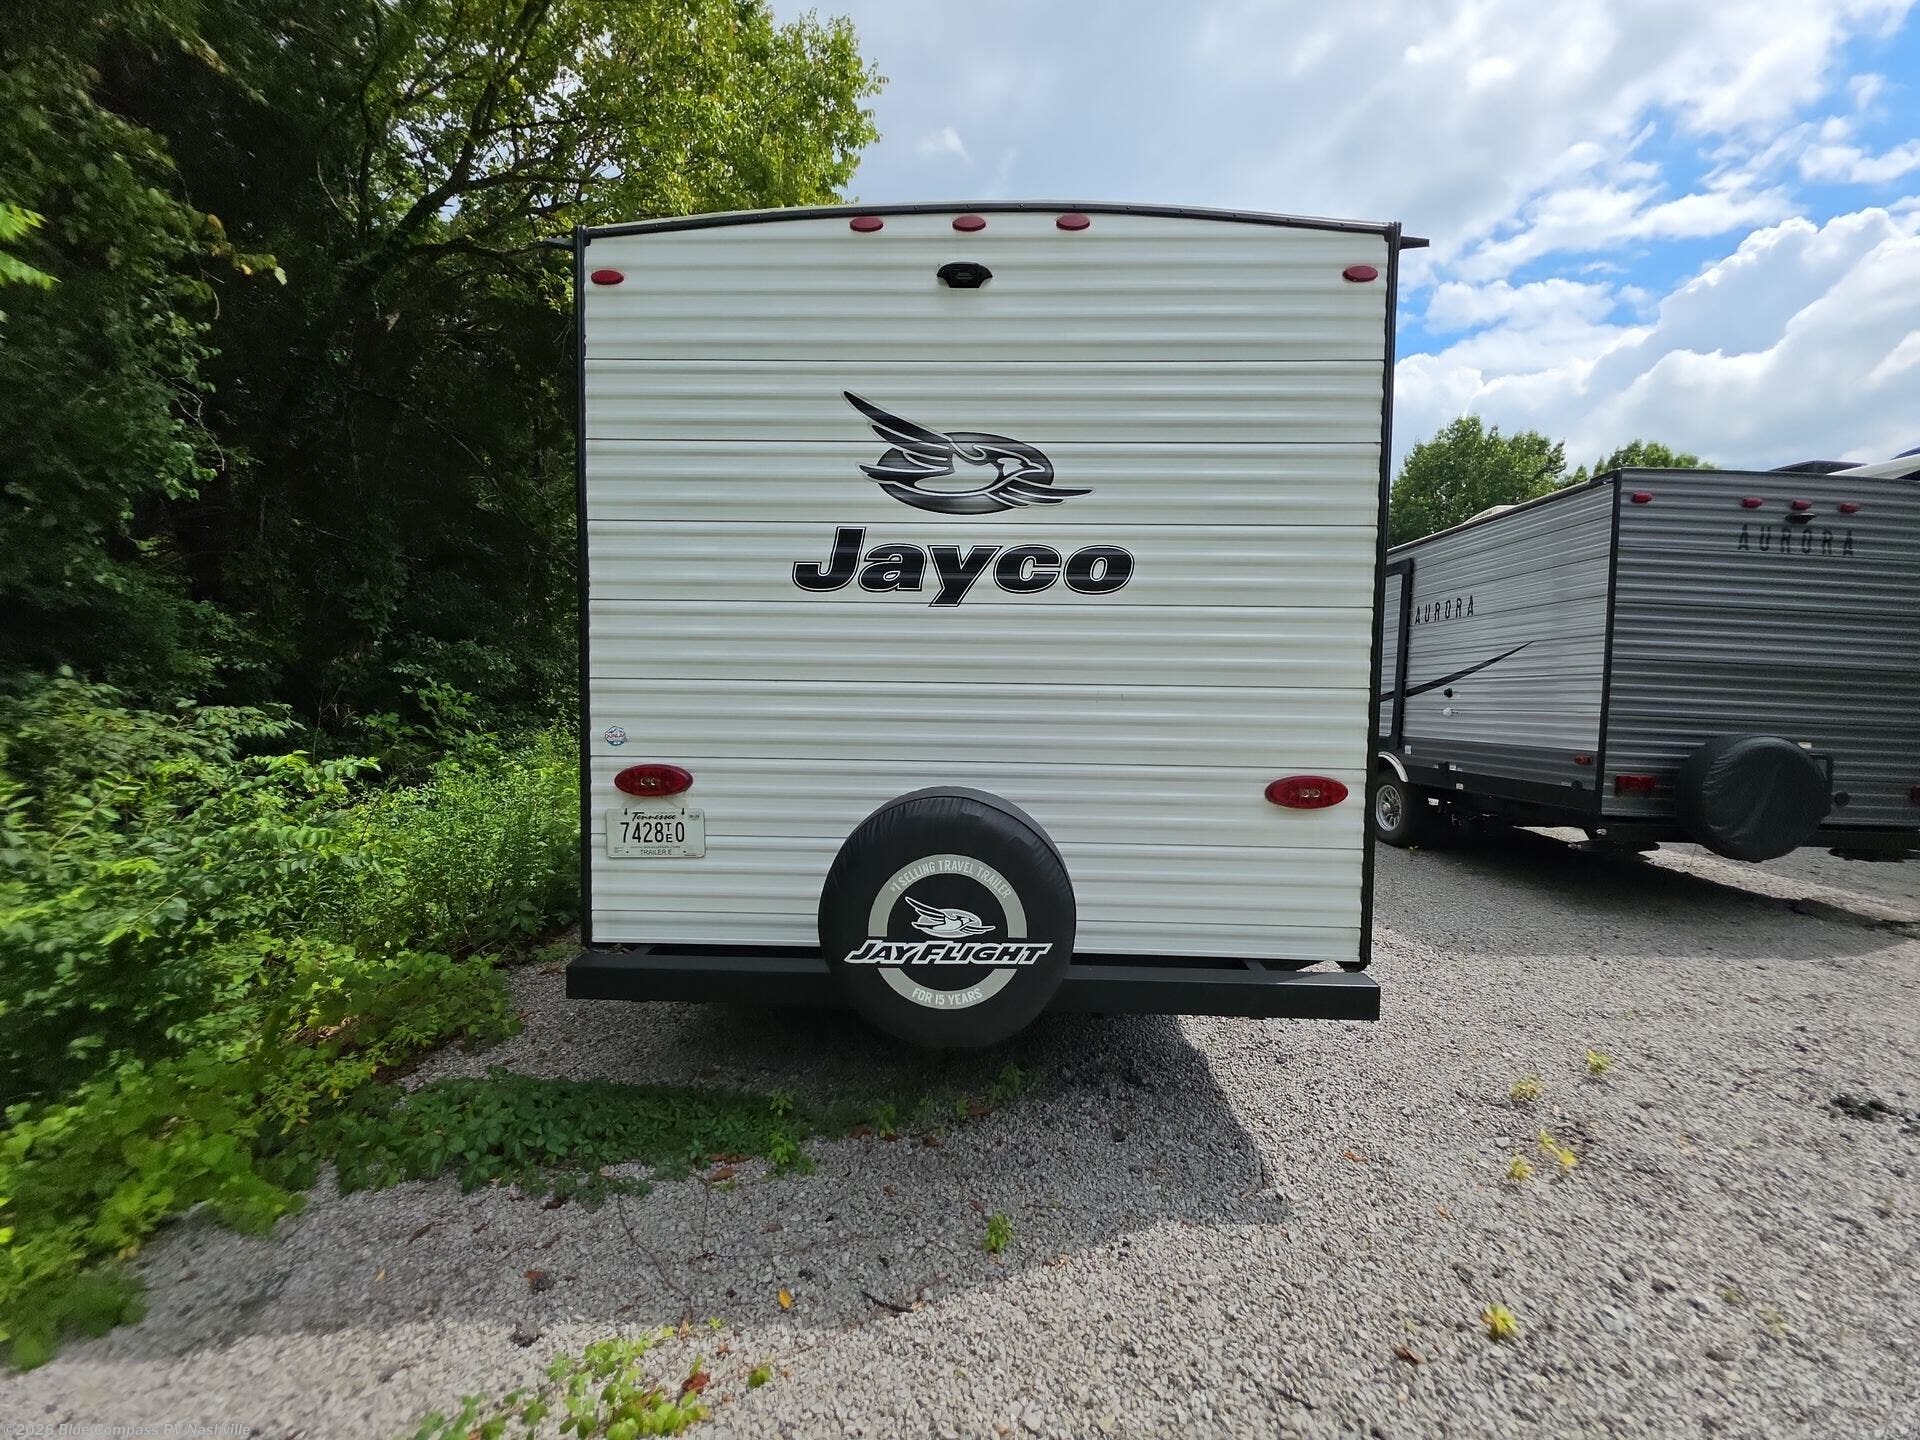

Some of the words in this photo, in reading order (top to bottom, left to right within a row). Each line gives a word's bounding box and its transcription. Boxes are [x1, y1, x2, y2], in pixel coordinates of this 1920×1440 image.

[1737, 524, 1855, 556] AURORA
[792, 526, 1135, 607] Jayco
[1415, 595, 1474, 625] AURORA
[632, 811, 676, 821] Tennessee
[898, 861, 935, 887] SELLING
[938, 860, 974, 875] TRAVEL
[977, 865, 1012, 899] TRAILER
[911, 987, 933, 1004] FOR
[935, 994, 945, 1005] 15
[947, 987, 983, 1005] YEARS
